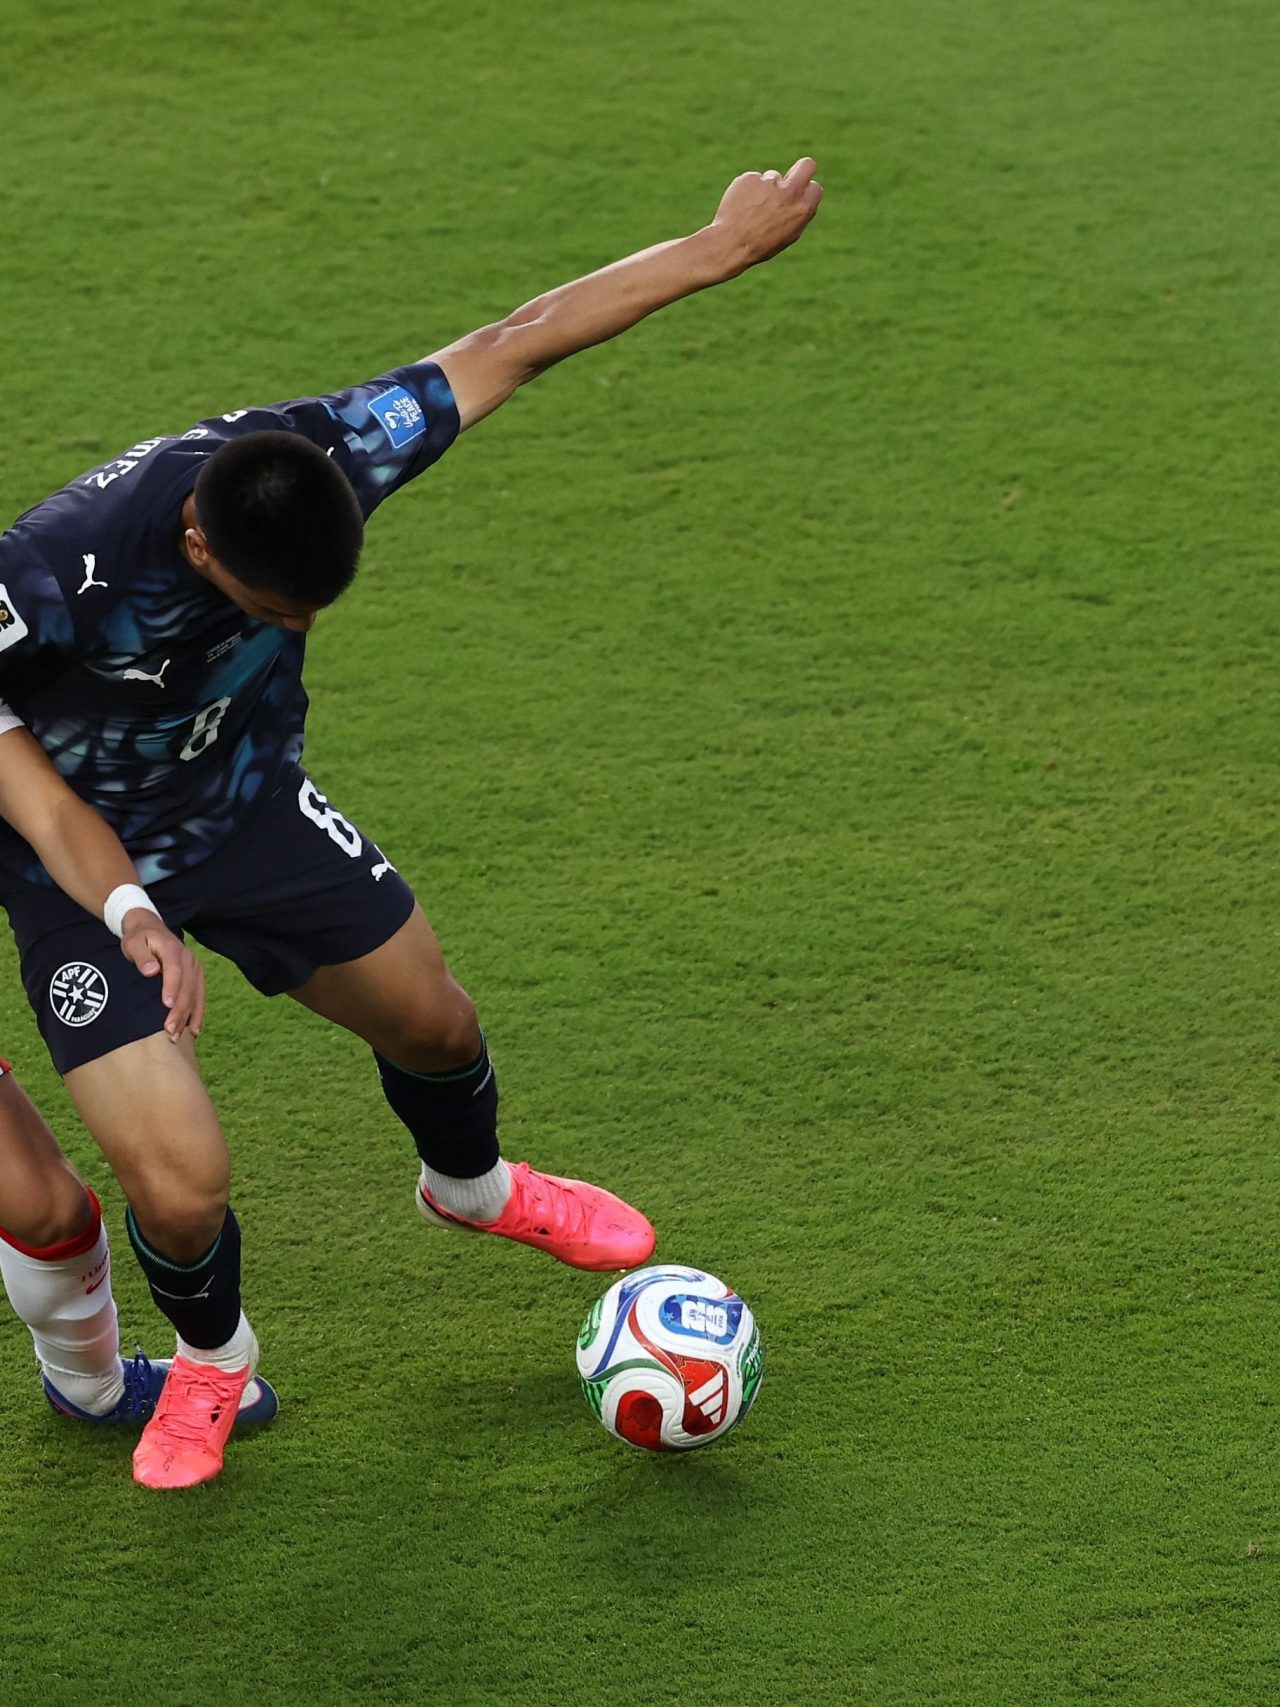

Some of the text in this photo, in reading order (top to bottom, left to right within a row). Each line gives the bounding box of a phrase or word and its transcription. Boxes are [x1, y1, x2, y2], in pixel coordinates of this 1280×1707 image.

[400, 396, 421, 423] PEACE
[180, 696, 232, 762] 8
[61, 965, 81, 983] APF
